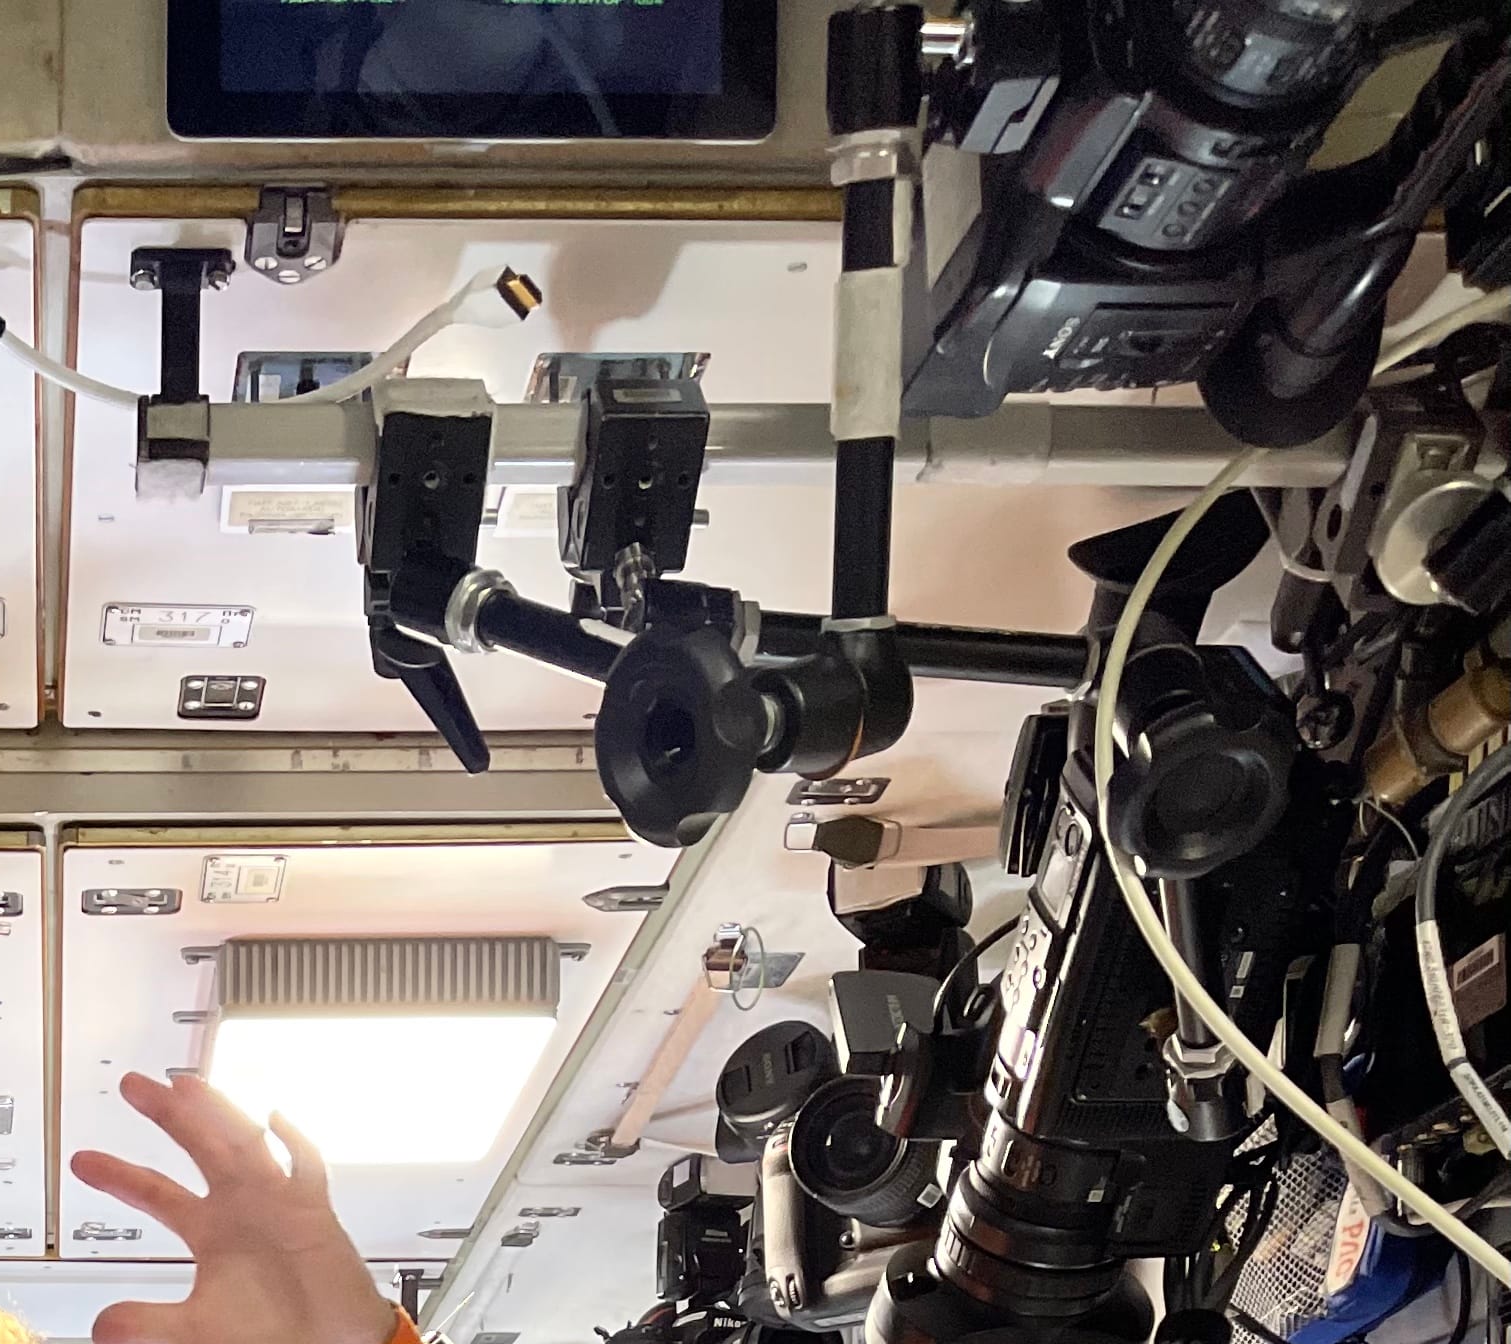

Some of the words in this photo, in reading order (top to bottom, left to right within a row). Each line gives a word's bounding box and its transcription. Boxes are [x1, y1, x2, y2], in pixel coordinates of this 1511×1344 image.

[1042, 316, 1081, 360] SONY
[158, 610, 213, 623] 317
[713, 1317, 748, 1328] Niko
